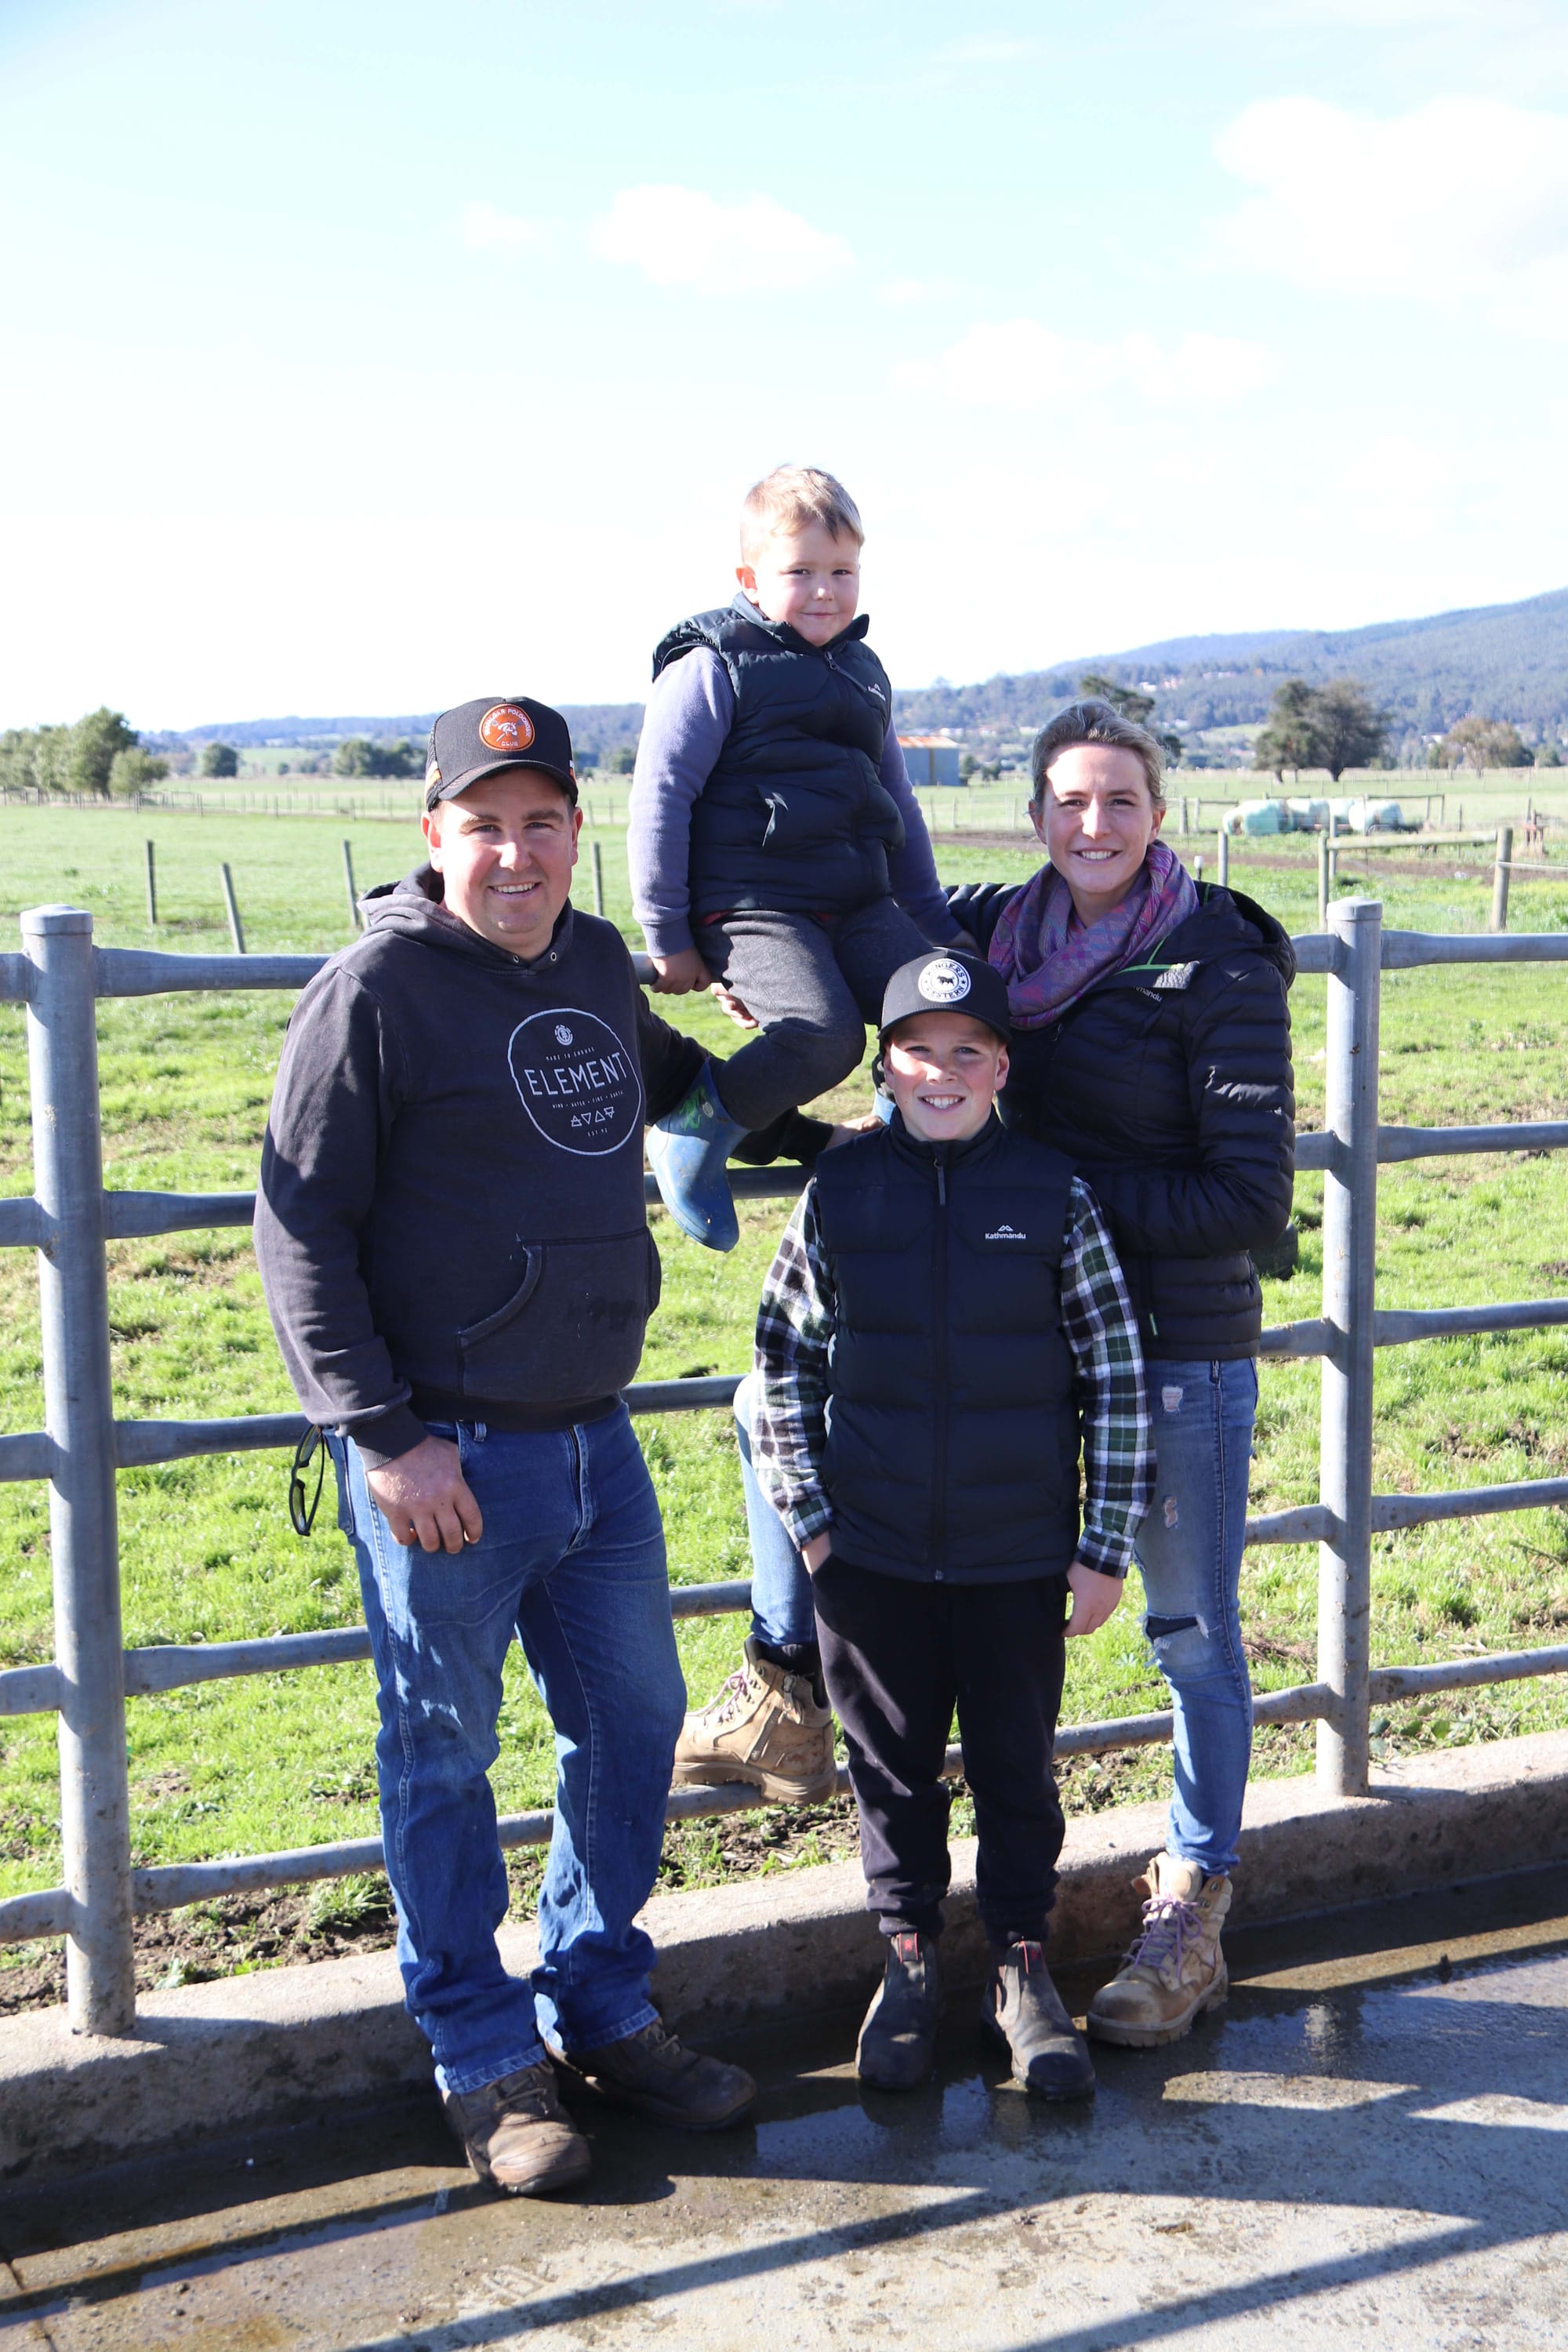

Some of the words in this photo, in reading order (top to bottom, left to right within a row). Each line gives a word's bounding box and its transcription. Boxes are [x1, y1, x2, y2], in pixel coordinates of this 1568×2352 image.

[926, 962, 966, 978] NGERS
[926, 985, 965, 998] ESTERN
[524, 1052, 627, 1095] ELEMENT
